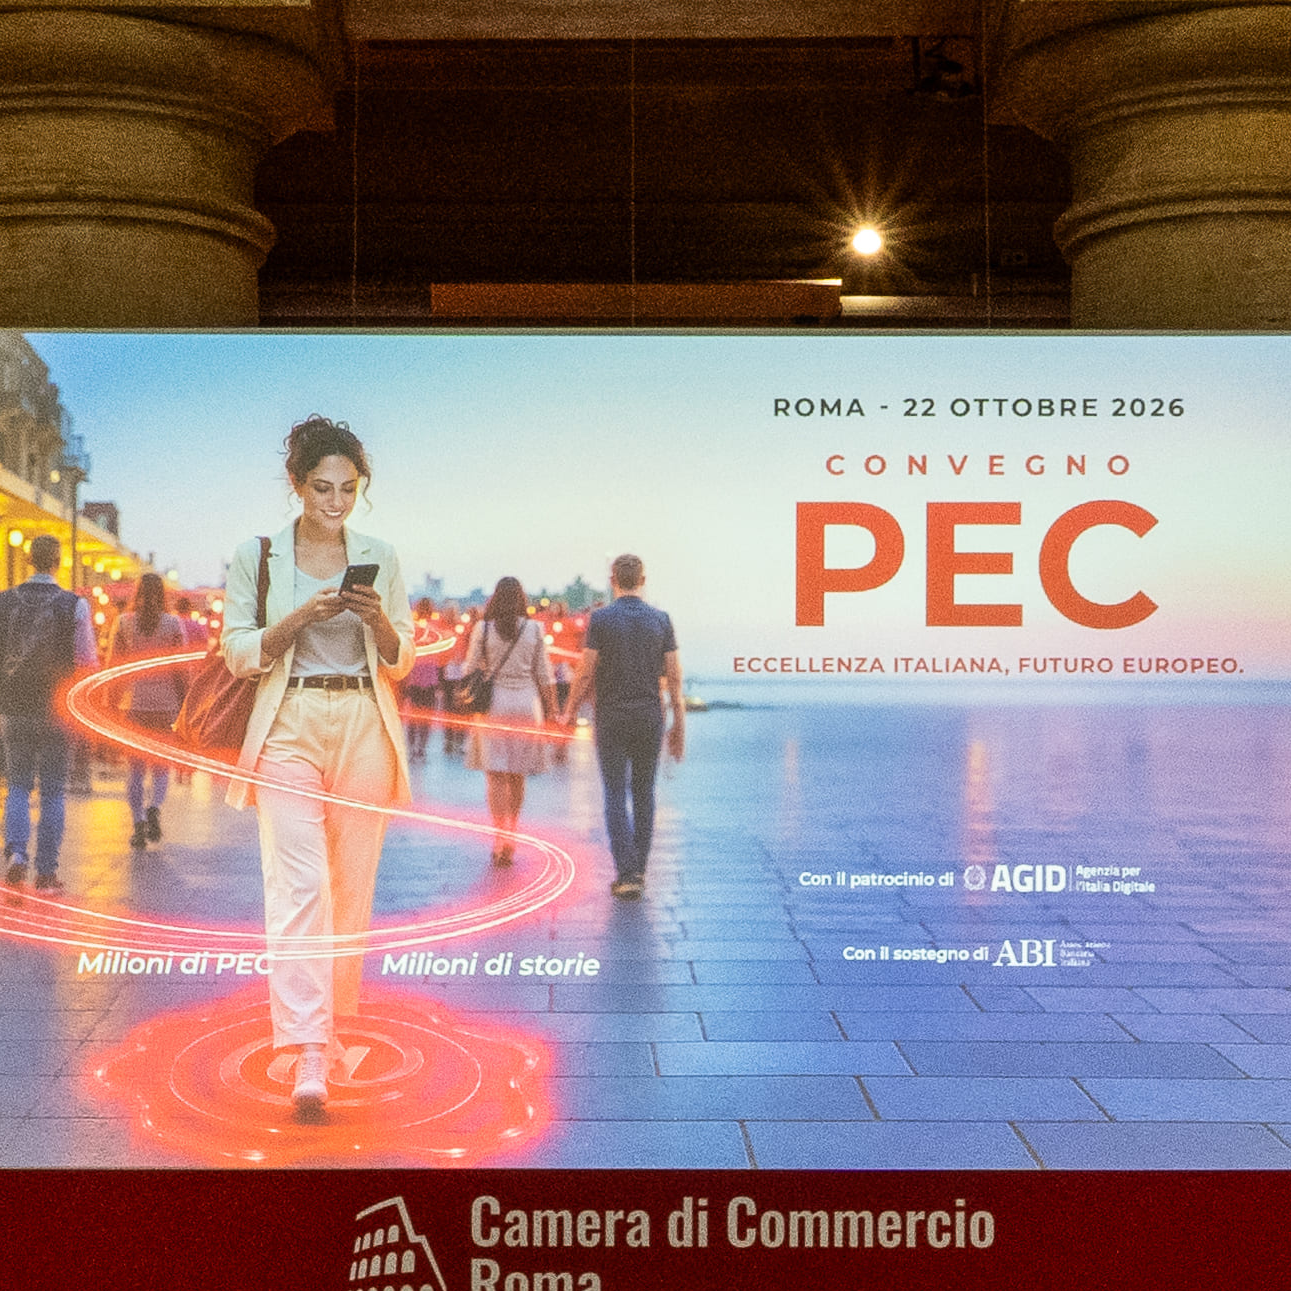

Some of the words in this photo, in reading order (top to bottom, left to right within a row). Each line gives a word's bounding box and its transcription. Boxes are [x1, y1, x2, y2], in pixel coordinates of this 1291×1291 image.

[774, 398, 864, 417] ROMA
[904, 398, 935, 416] 22
[950, 398, 1097, 417] OTTOBRE
[1112, 398, 1184, 417] 2026
[826, 455, 1129, 475] CONVEGNO
[796, 500, 1158, 630] PEC
[734, 657, 885, 673] ECCELLENZA
[894, 658, 1009, 675] ITALIANA,
[1019, 657, 1113, 673] FUTURO
[1123, 658, 1243, 673] EUROPEO.
[799, 872, 831, 886] Con
[837, 871, 846, 886] il
[850, 872, 935, 889] patrocinio
[938, 872, 954, 886] di
[991, 864, 1066, 892] AGID
[1076, 865, 1120, 879] Agenzia
[1122, 867, 1141, 878] per
[1113, 881, 1155, 895] Digitale
[77, 951, 173, 975] Milioni
[182, 952, 211, 975] di
[215, 953, 275, 975] PEC
[382, 951, 478, 975] Milioni
[484, 952, 513, 975] di
[519, 952, 600, 976] storie
[843, 947, 876, 960] Con
[880, 946, 889, 960] il
[893, 946, 970, 964] sostegno
[975, 946, 989, 960] di
[993, 940, 1056, 966] ABI
[471, 1195, 650, 1247] Camera
[668, 1196, 708, 1248] di
[727, 1196, 995, 1249] Commercio
